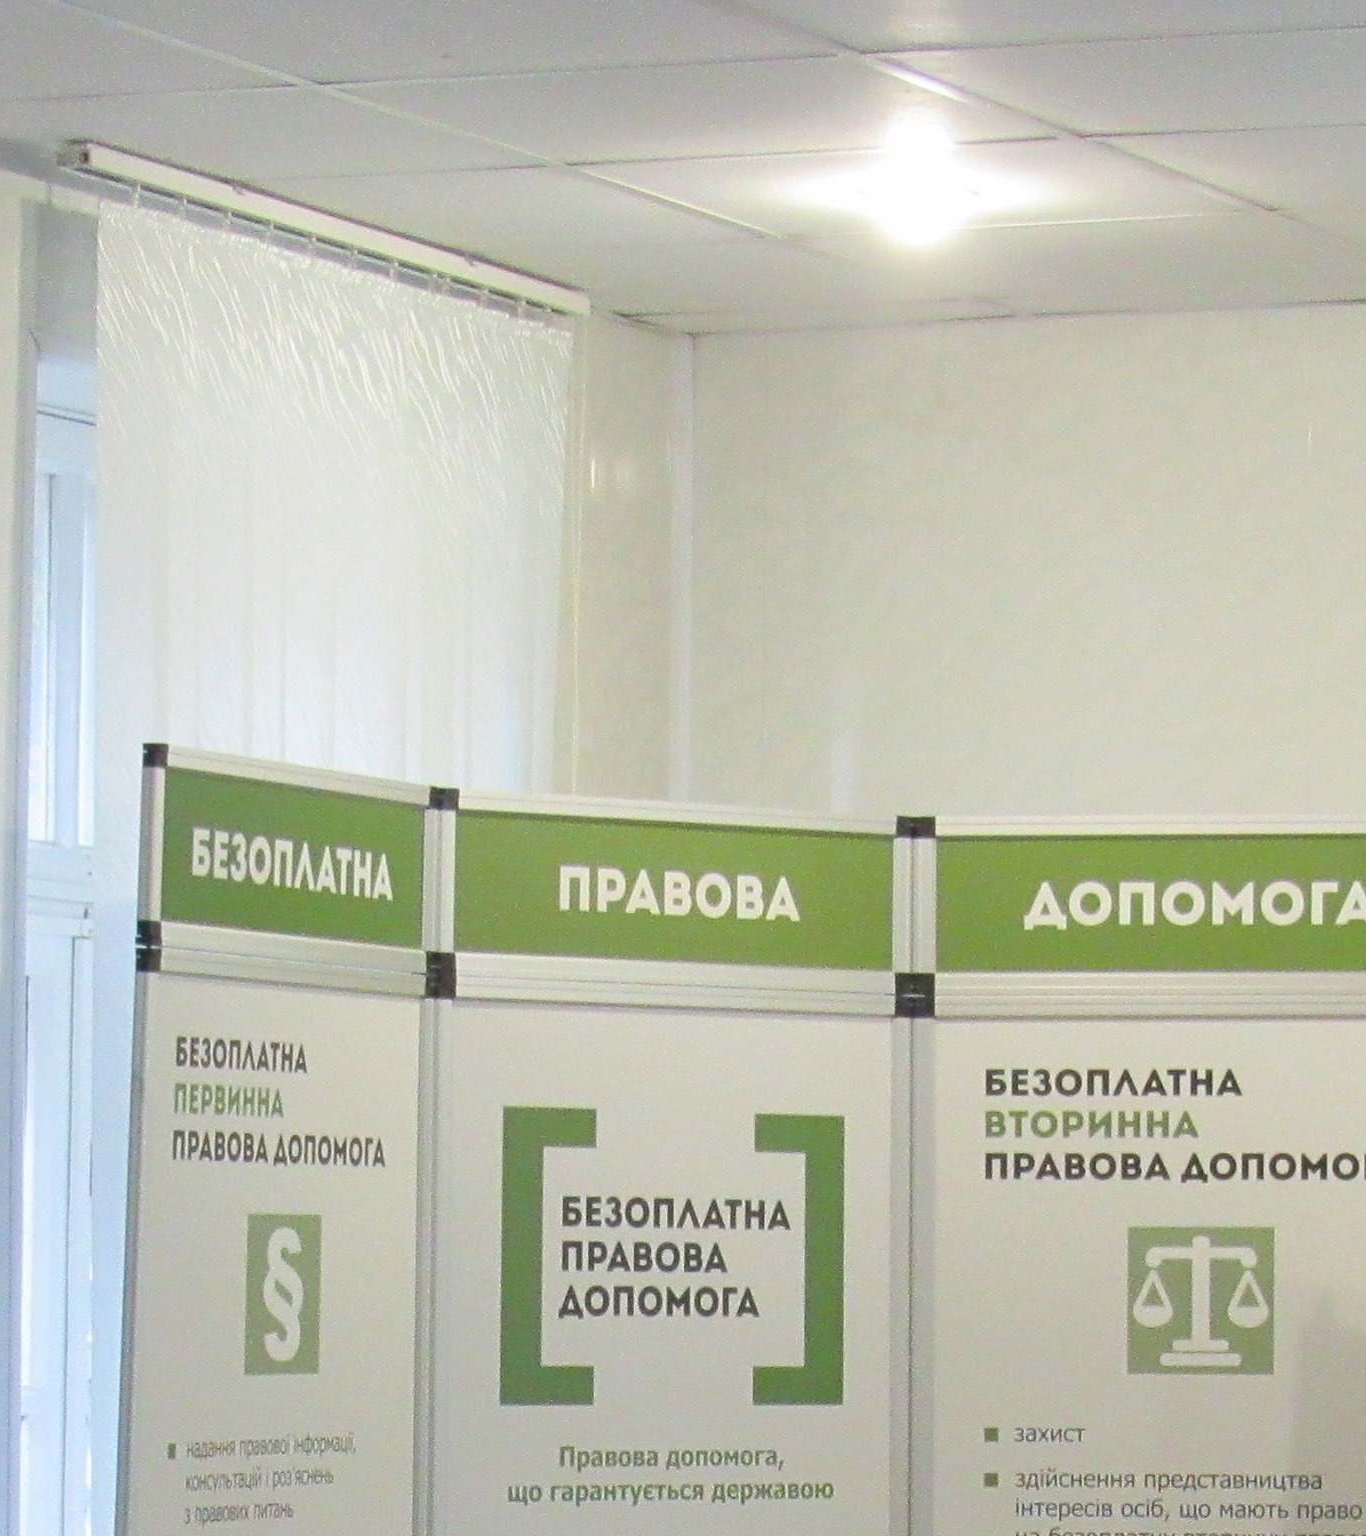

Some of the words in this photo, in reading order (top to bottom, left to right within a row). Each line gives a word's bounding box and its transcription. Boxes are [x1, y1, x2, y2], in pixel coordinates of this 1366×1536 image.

[191, 827, 394, 901] БЕЗОПЛАТНА
[559, 865, 800, 922] ПРАВОВА
[175, 1036, 308, 1075] БЕЗОПЛАТНА
[984, 1068, 1242, 1098] БЕЗОПЛАТНА
[173, 1082, 284, 1118] ПЕРВИННА
[984, 1110, 1199, 1140] ВТОРИННА
[172, 1131, 268, 1165] ПРАВОВА
[273, 1134, 386, 1168] ДОПОМОГА
[984, 1153, 1170, 1182] ПРАВОВА
[561, 1196, 792, 1231] БЕЗОПЛАТНА
[561, 1240, 728, 1273] ПРАВОВА
[558, 1285, 760, 1319] ДОПОМОГА
[186, 1440, 236, 1459] надання
[1013, 1426, 1086, 1444] захист
[558, 1446, 659, 1472] Правова
[665, 1447, 785, 1471] допомога,
[186, 1466, 262, 1492] консультацій
[507, 1483, 542, 1505] що
[550, 1482, 704, 1506] гарантується
[711, 1481, 834, 1505] державою
[1015, 1467, 1135, 1490] здійснення
[1143, 1471, 1323, 1492] представництва
[195, 1505, 249, 1528] правових
[253, 1503, 294, 1520] питань
[1014, 1501, 1112, 1521] інтересів
[1121, 1501, 1170, 1522] осіб,
[1179, 1504, 1211, 1521] що
[1219, 1503, 1290, 1520] мають
[1297, 1503, 1363, 1522] право
